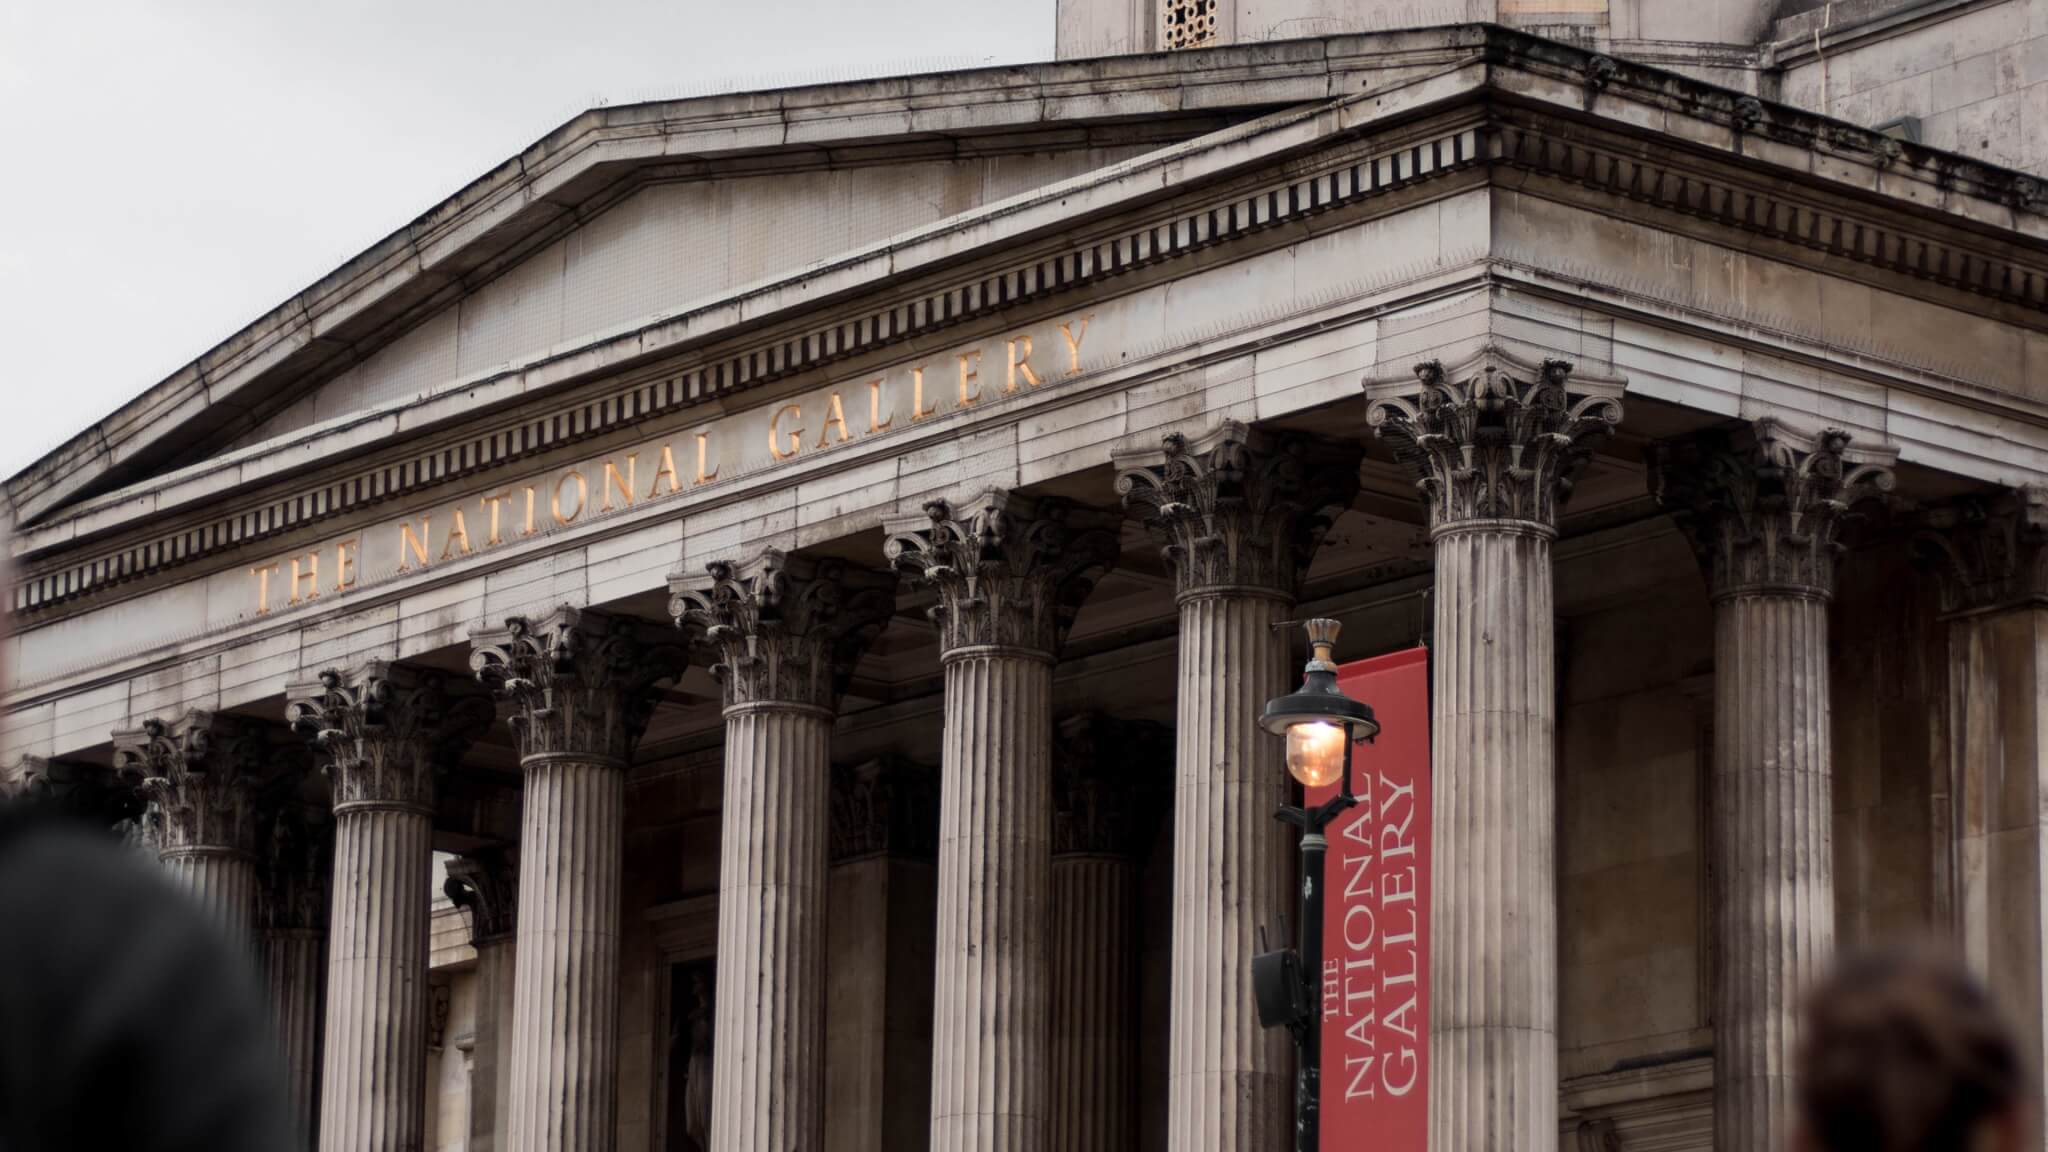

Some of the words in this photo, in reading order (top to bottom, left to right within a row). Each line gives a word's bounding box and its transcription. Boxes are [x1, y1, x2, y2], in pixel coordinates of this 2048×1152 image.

[251, 539, 358, 616] THE
[397, 431, 721, 573] NATIONAL
[769, 313, 1095, 461] GALLERY
[1323, 957, 1340, 1023] THE
[1342, 772, 1374, 1104] NATIONAL
[1380, 768, 1417, 1097] GALLERY
